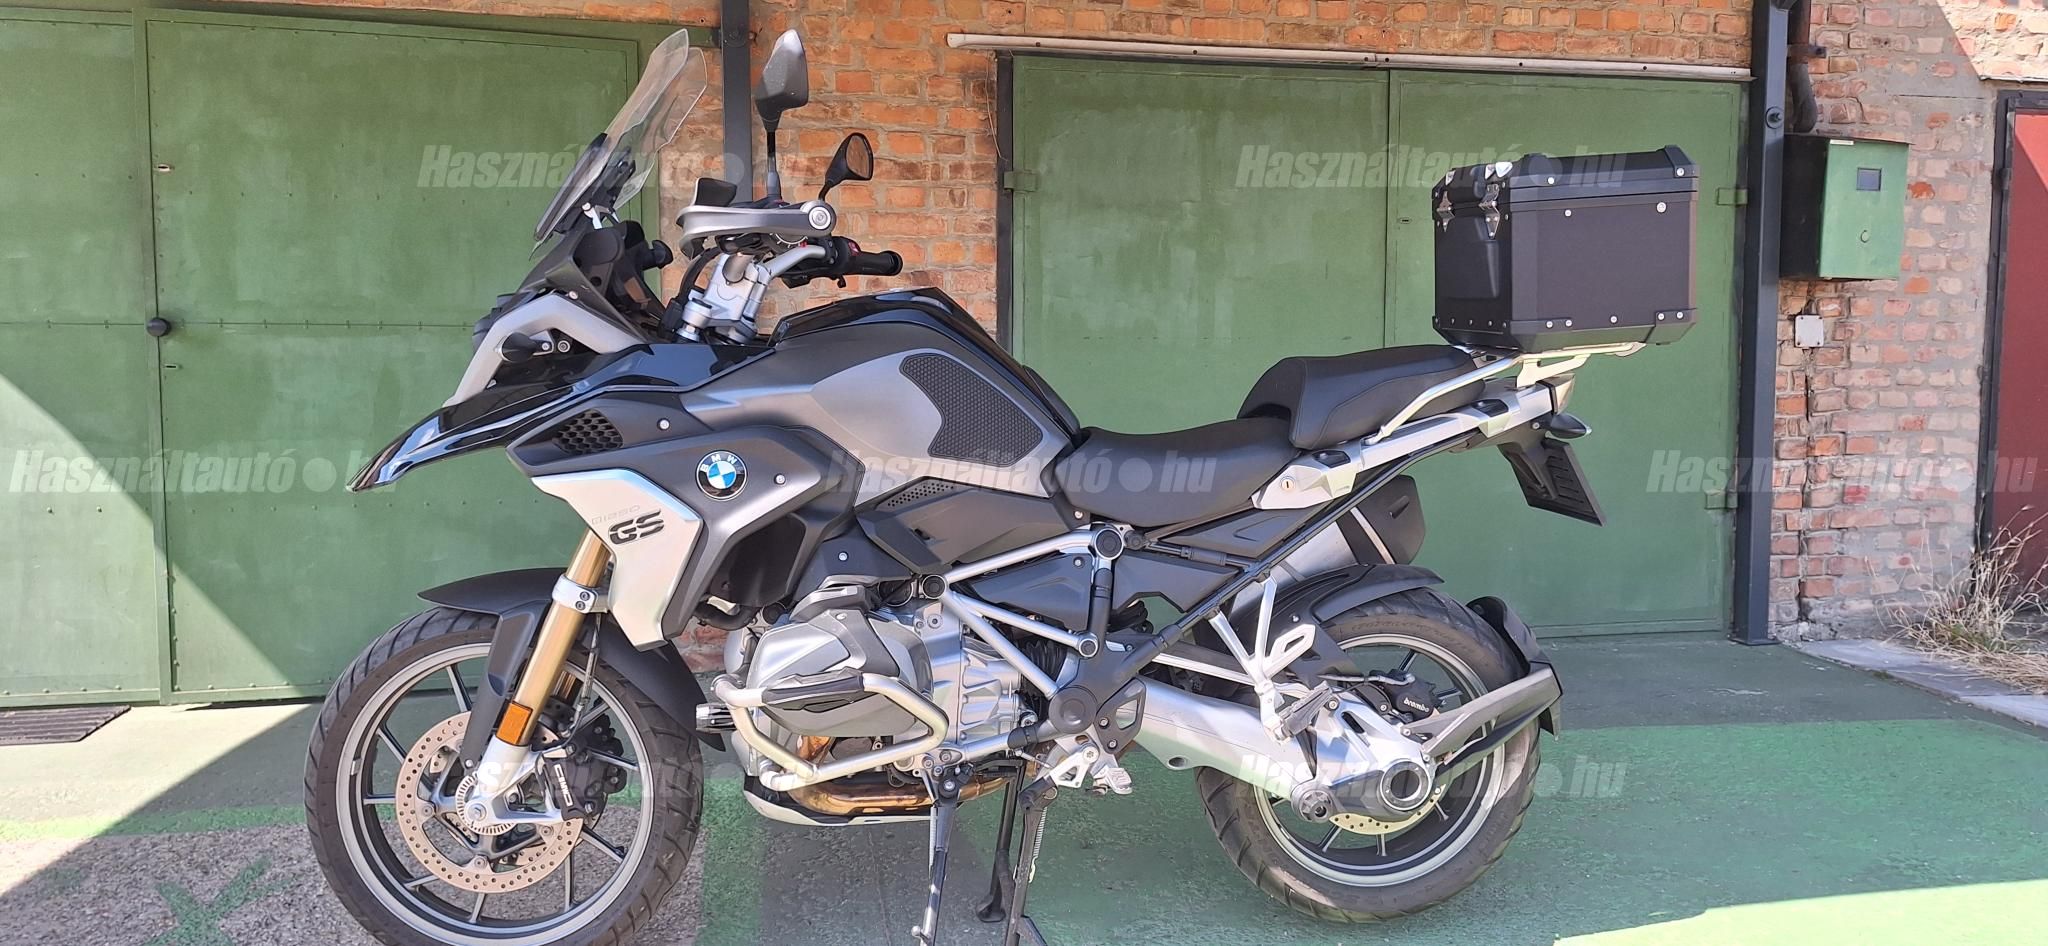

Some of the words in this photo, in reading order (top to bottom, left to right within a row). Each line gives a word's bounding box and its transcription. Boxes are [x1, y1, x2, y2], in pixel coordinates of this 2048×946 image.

[700, 454, 738, 473] BMW
[608, 508, 665, 545] GS
[1403, 697, 1430, 713] brembo
